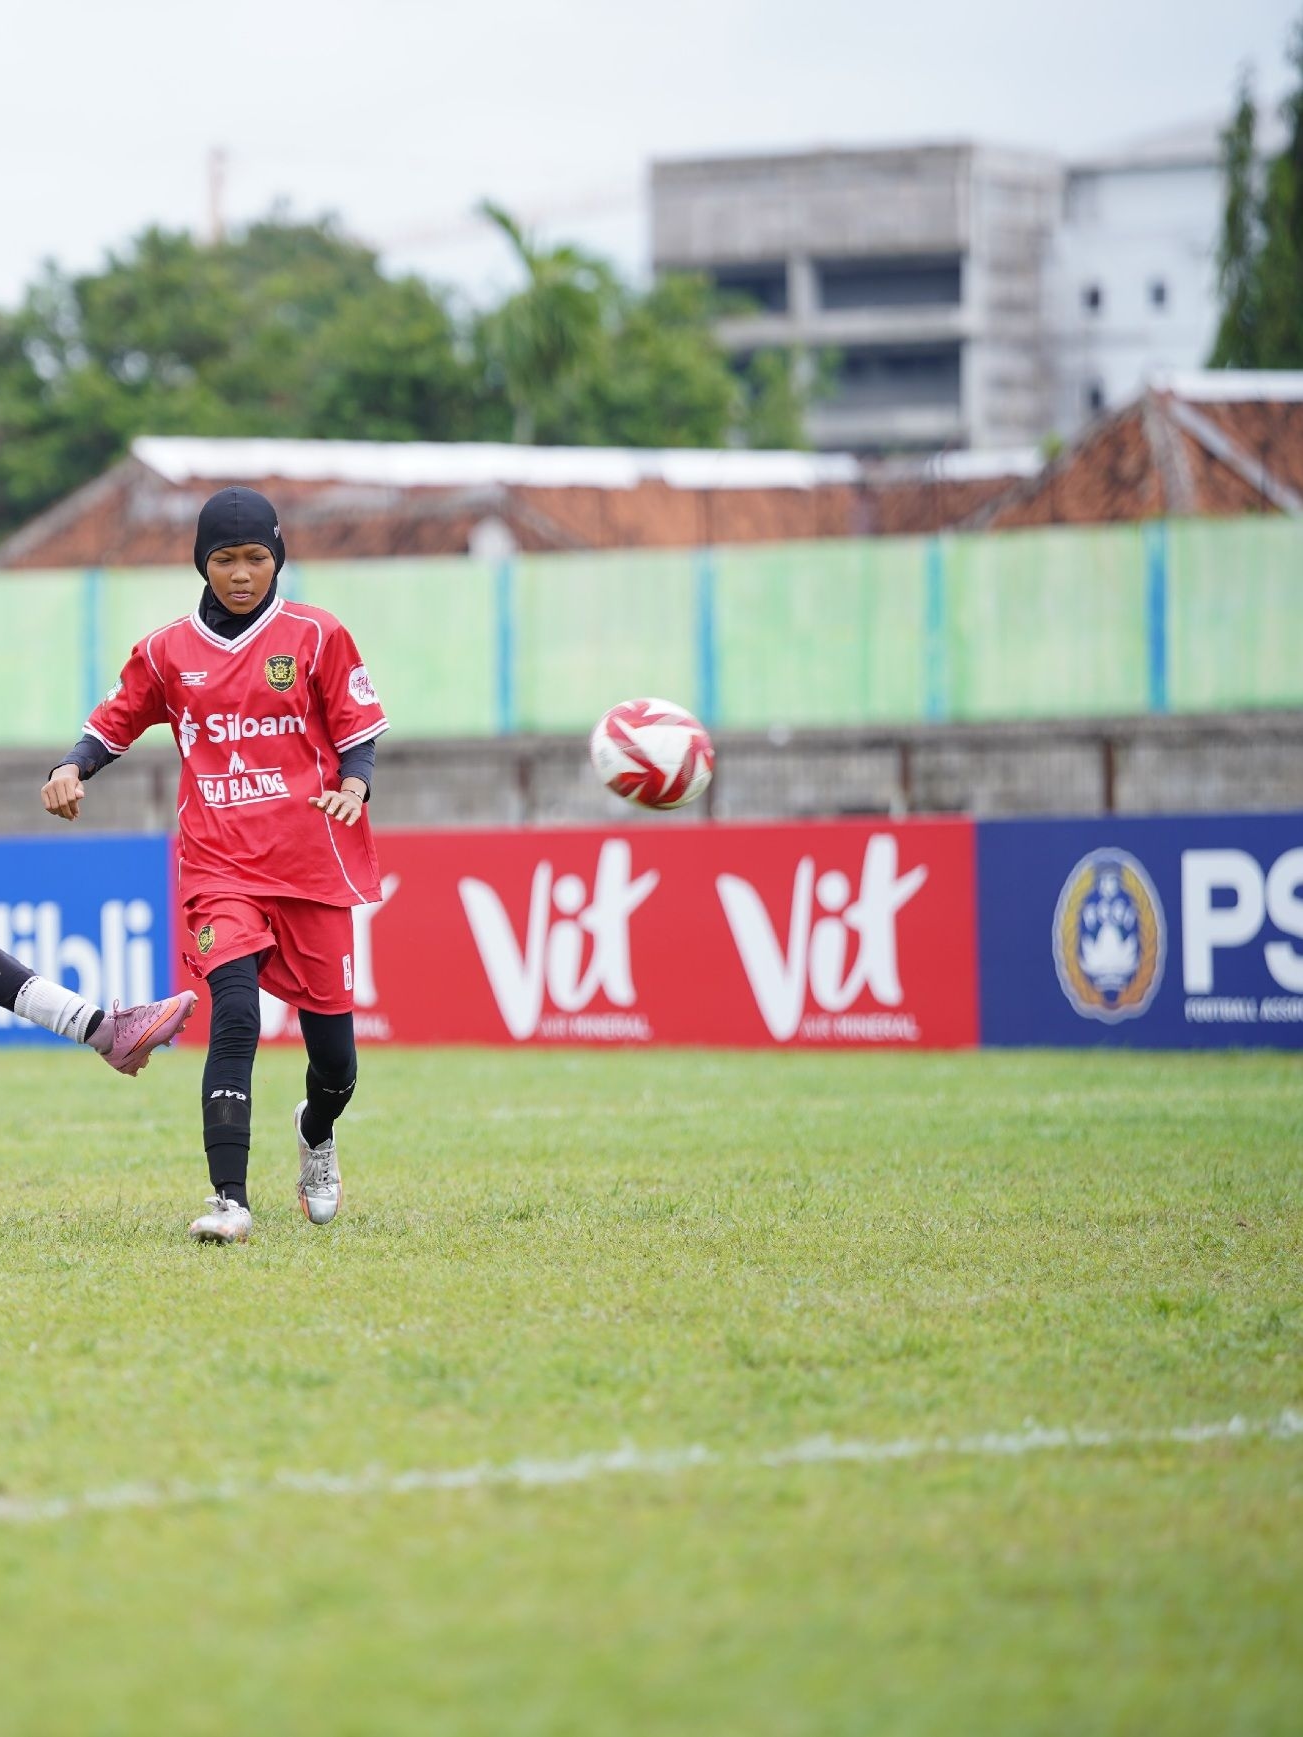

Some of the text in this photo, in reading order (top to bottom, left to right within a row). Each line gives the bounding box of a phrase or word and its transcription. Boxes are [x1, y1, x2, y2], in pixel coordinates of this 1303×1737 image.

[205, 712, 305, 743] Siloam
[229, 773, 288, 801] BAJOG
[457, 837, 660, 1040] Vit
[715, 832, 929, 1042] Vit
[1184, 997, 1258, 1023] FOOTBALL
[568, 1014, 652, 1041] MINERAL
[833, 1013, 919, 1041] MINERAL
